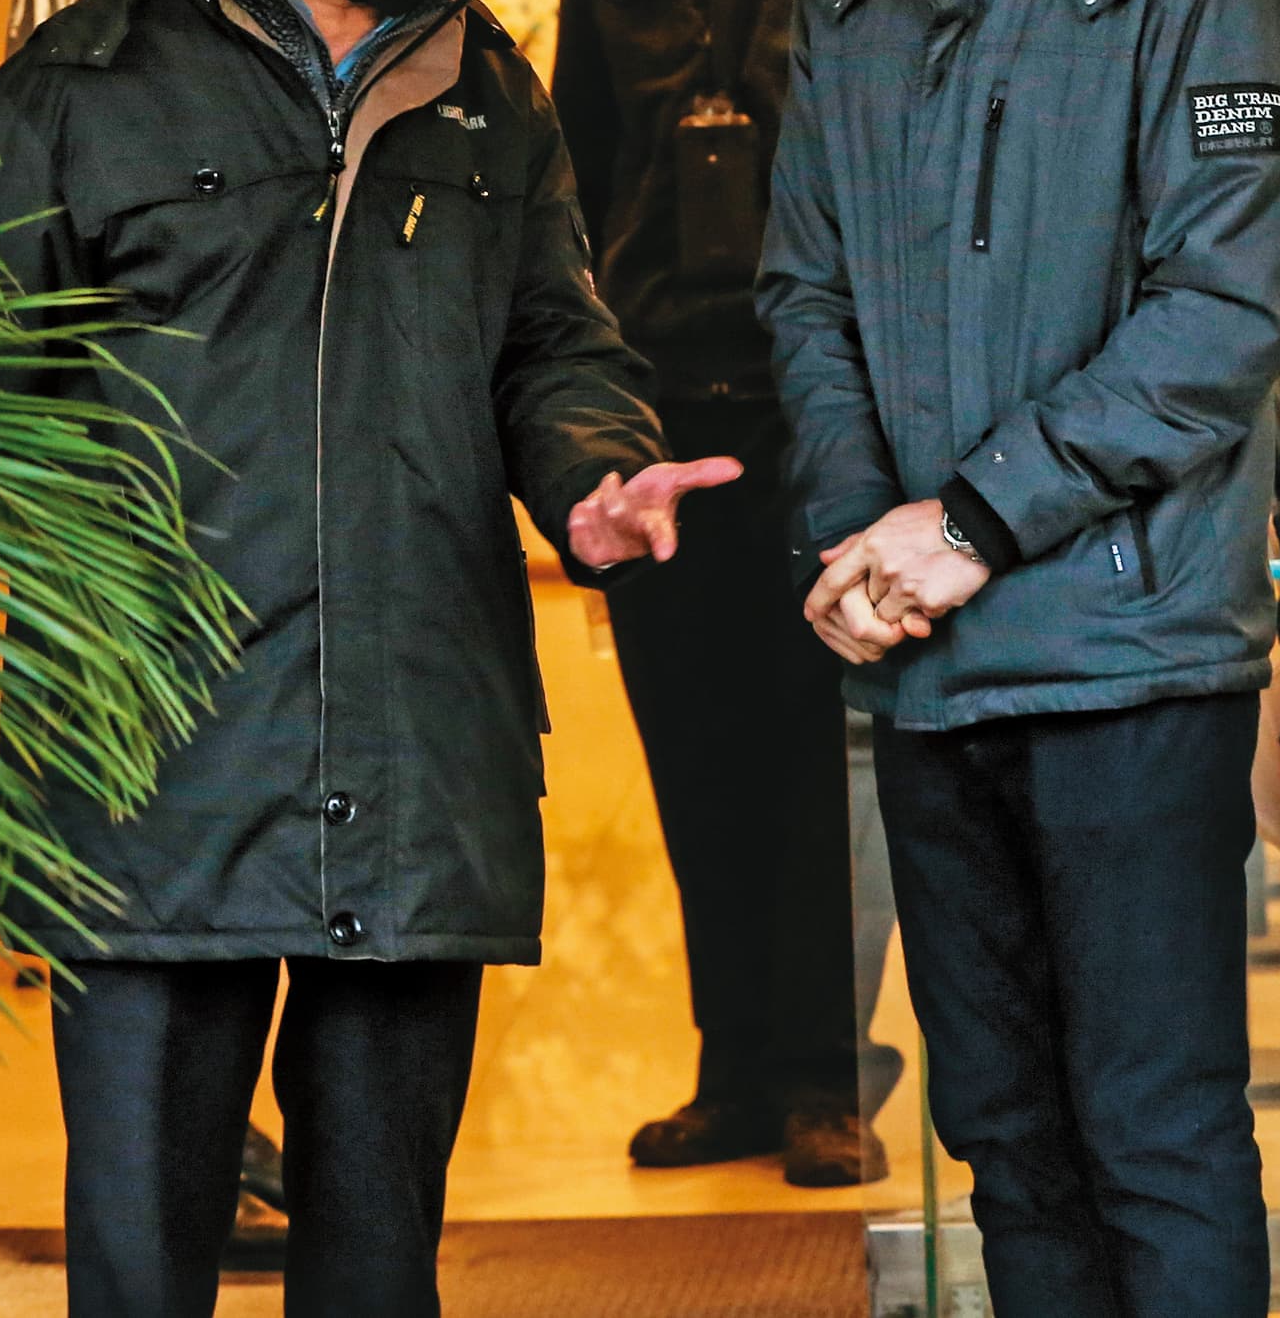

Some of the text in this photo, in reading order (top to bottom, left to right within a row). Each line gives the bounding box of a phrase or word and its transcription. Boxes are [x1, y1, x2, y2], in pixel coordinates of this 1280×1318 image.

[1194, 94, 1228, 110] BIG
[1195, 107, 1273, 124] DENIM
[1197, 121, 1256, 138] JEANS
